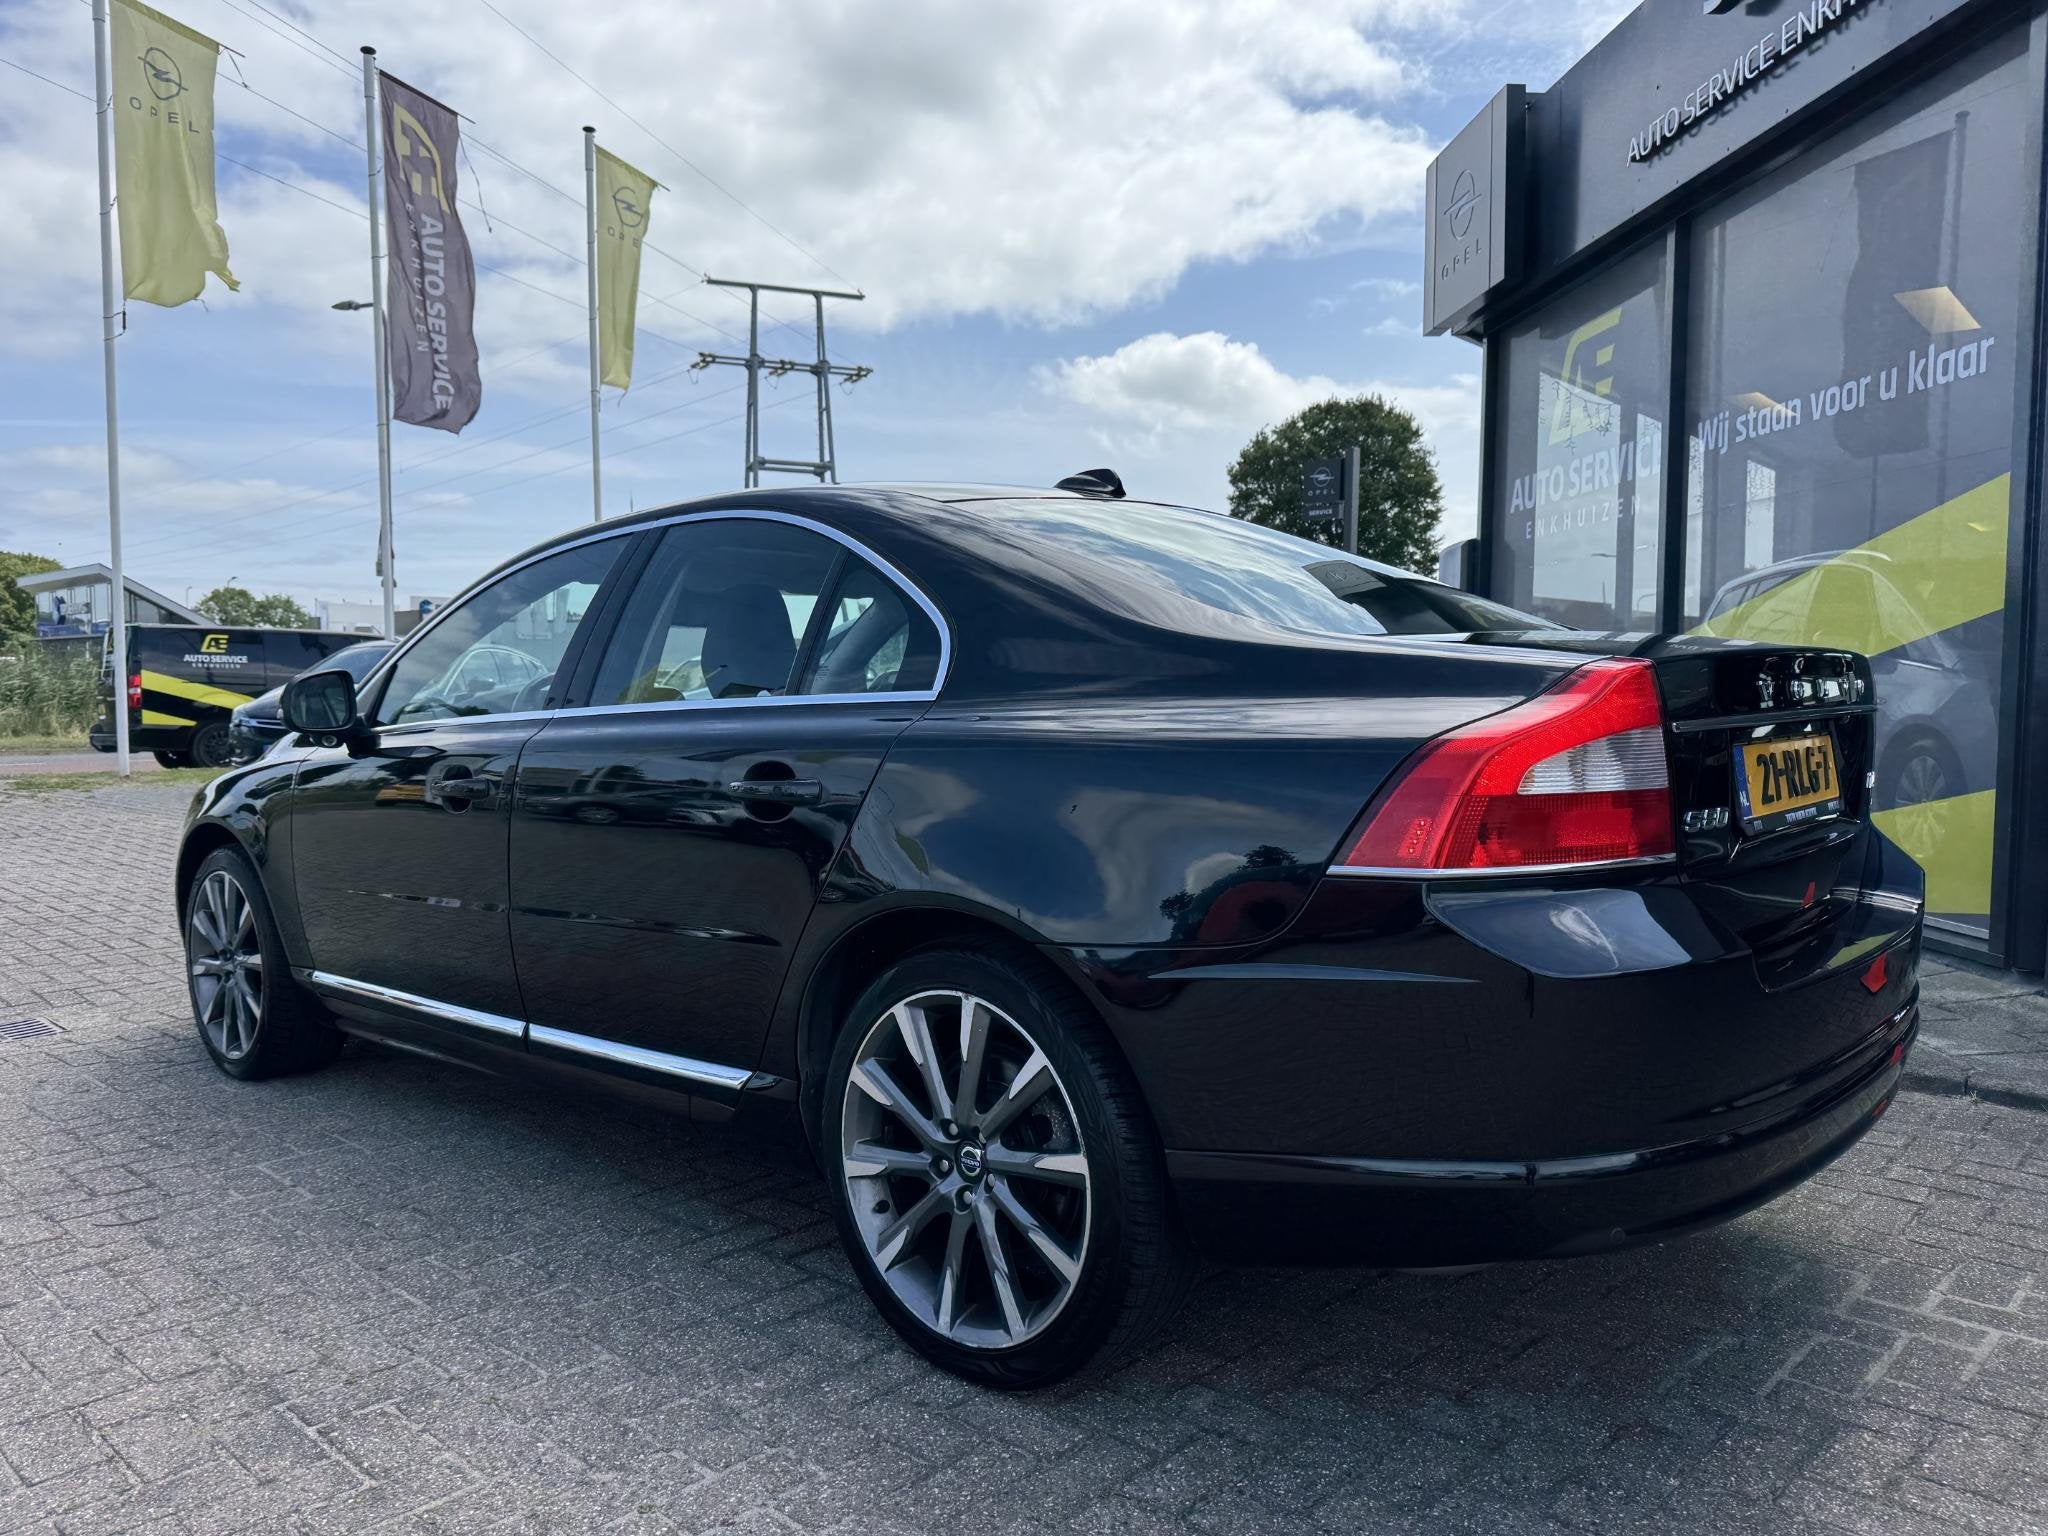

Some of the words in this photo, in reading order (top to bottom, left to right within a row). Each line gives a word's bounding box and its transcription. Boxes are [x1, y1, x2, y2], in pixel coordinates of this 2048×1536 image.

[129, 96, 200, 133] OPEL
[1626, 106, 1680, 167] AUTO
[1683, 33, 1775, 126] SERVICE
[1781, 0, 1857, 55] ENK
[404, 202, 429, 352] ENKHUIZEN
[420, 213, 445, 297] AUTO
[1441, 238, 1482, 280] OPEL
[426, 302, 455, 410] SERVICE
[1698, 411, 1730, 454] Wij
[1735, 397, 1801, 443] staan
[1810, 374, 1871, 421] voor
[1879, 366, 1898, 401] u
[1907, 336, 1995, 394] klaar
[1510, 465, 1564, 514] AUTO
[1525, 495, 1641, 539] ENKHUIZEN
[184, 654, 210, 662] AUTO
[210, 655, 248, 663] SERVICE
[1756, 744, 1832, 806] 21-RLG-7
